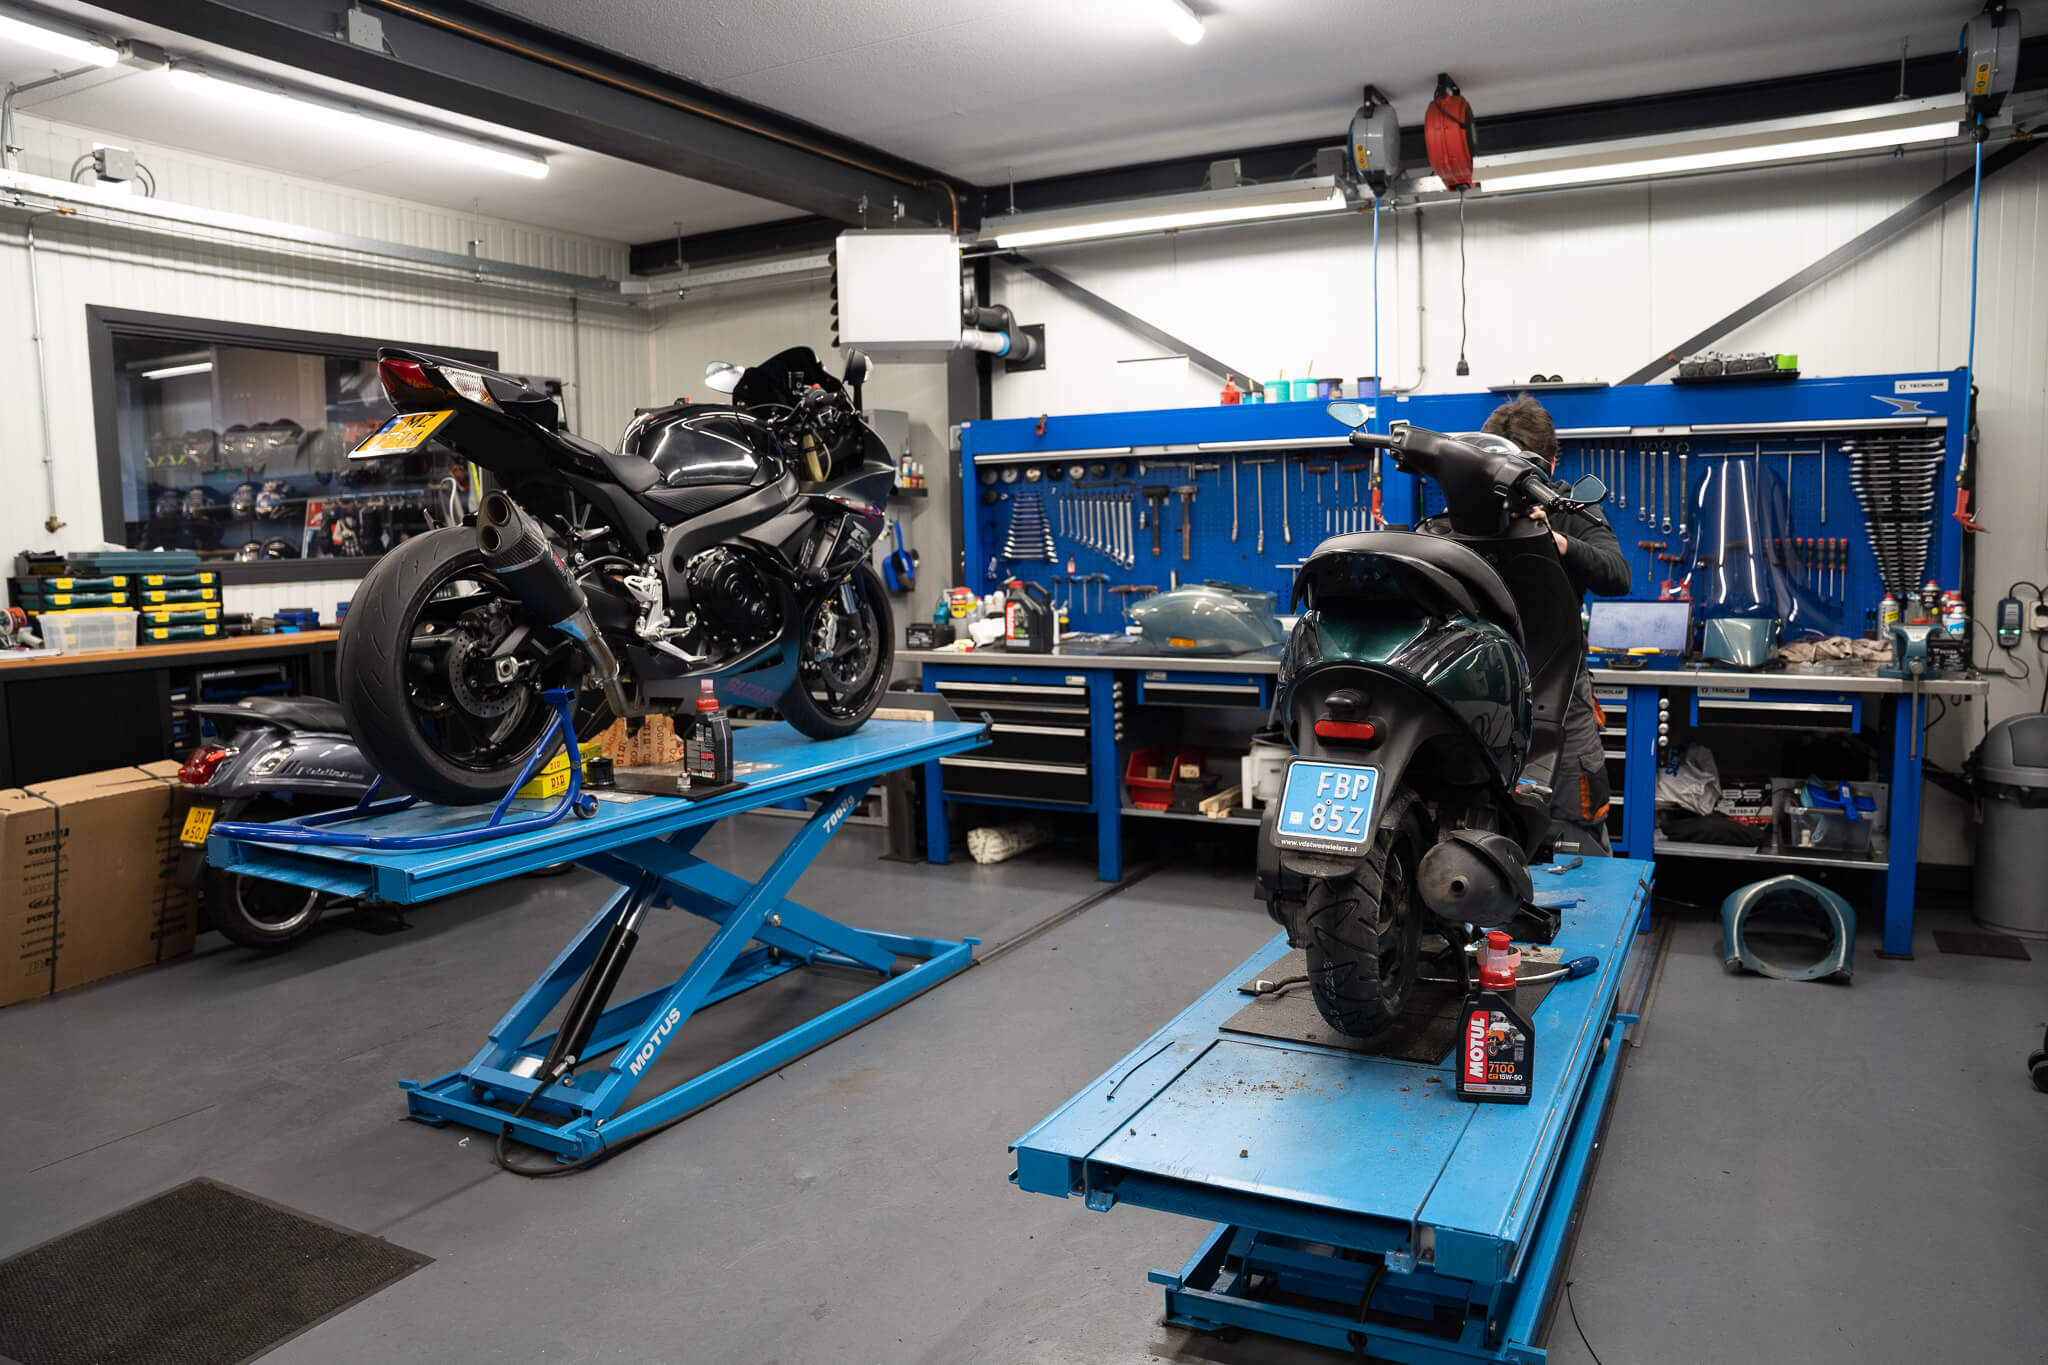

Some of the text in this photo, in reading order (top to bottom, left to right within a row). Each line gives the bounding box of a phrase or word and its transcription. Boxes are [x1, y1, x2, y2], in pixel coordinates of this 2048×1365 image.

[1316, 771, 1369, 801] FBP
[194, 810, 212, 825] DXT
[1309, 803, 1365, 835] 85Z
[629, 1007, 681, 1077] MOTUS
[1468, 1017, 1486, 1079] MOTUL
[1488, 1063, 1516, 1074] 7100
